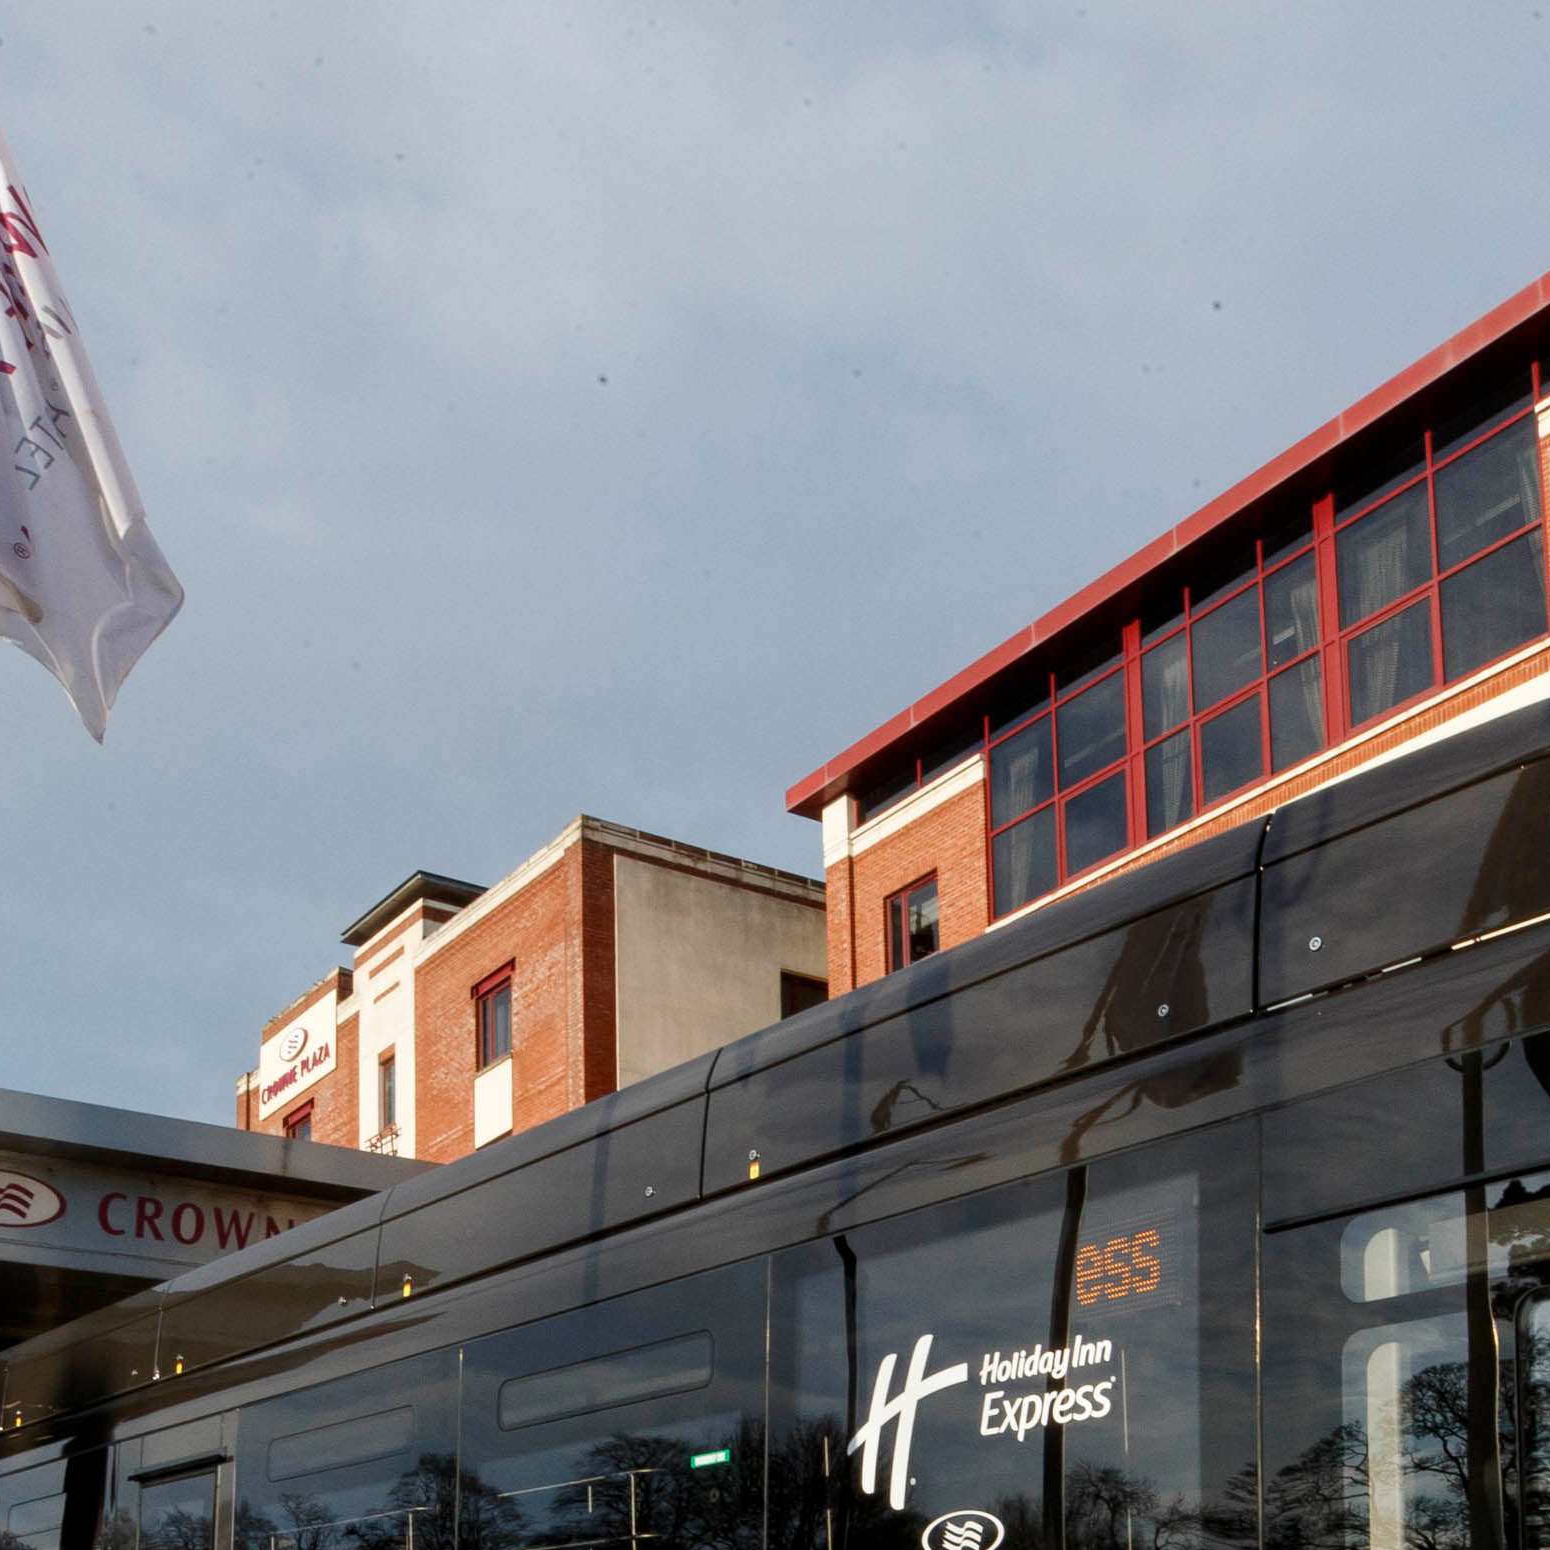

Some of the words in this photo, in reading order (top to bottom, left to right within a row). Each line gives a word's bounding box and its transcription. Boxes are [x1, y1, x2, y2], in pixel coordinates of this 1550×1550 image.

[979, 1344, 1070, 1386] Holiday
[1072, 1335, 1112, 1368] Inn
[980, 1381, 1112, 1441] Express
